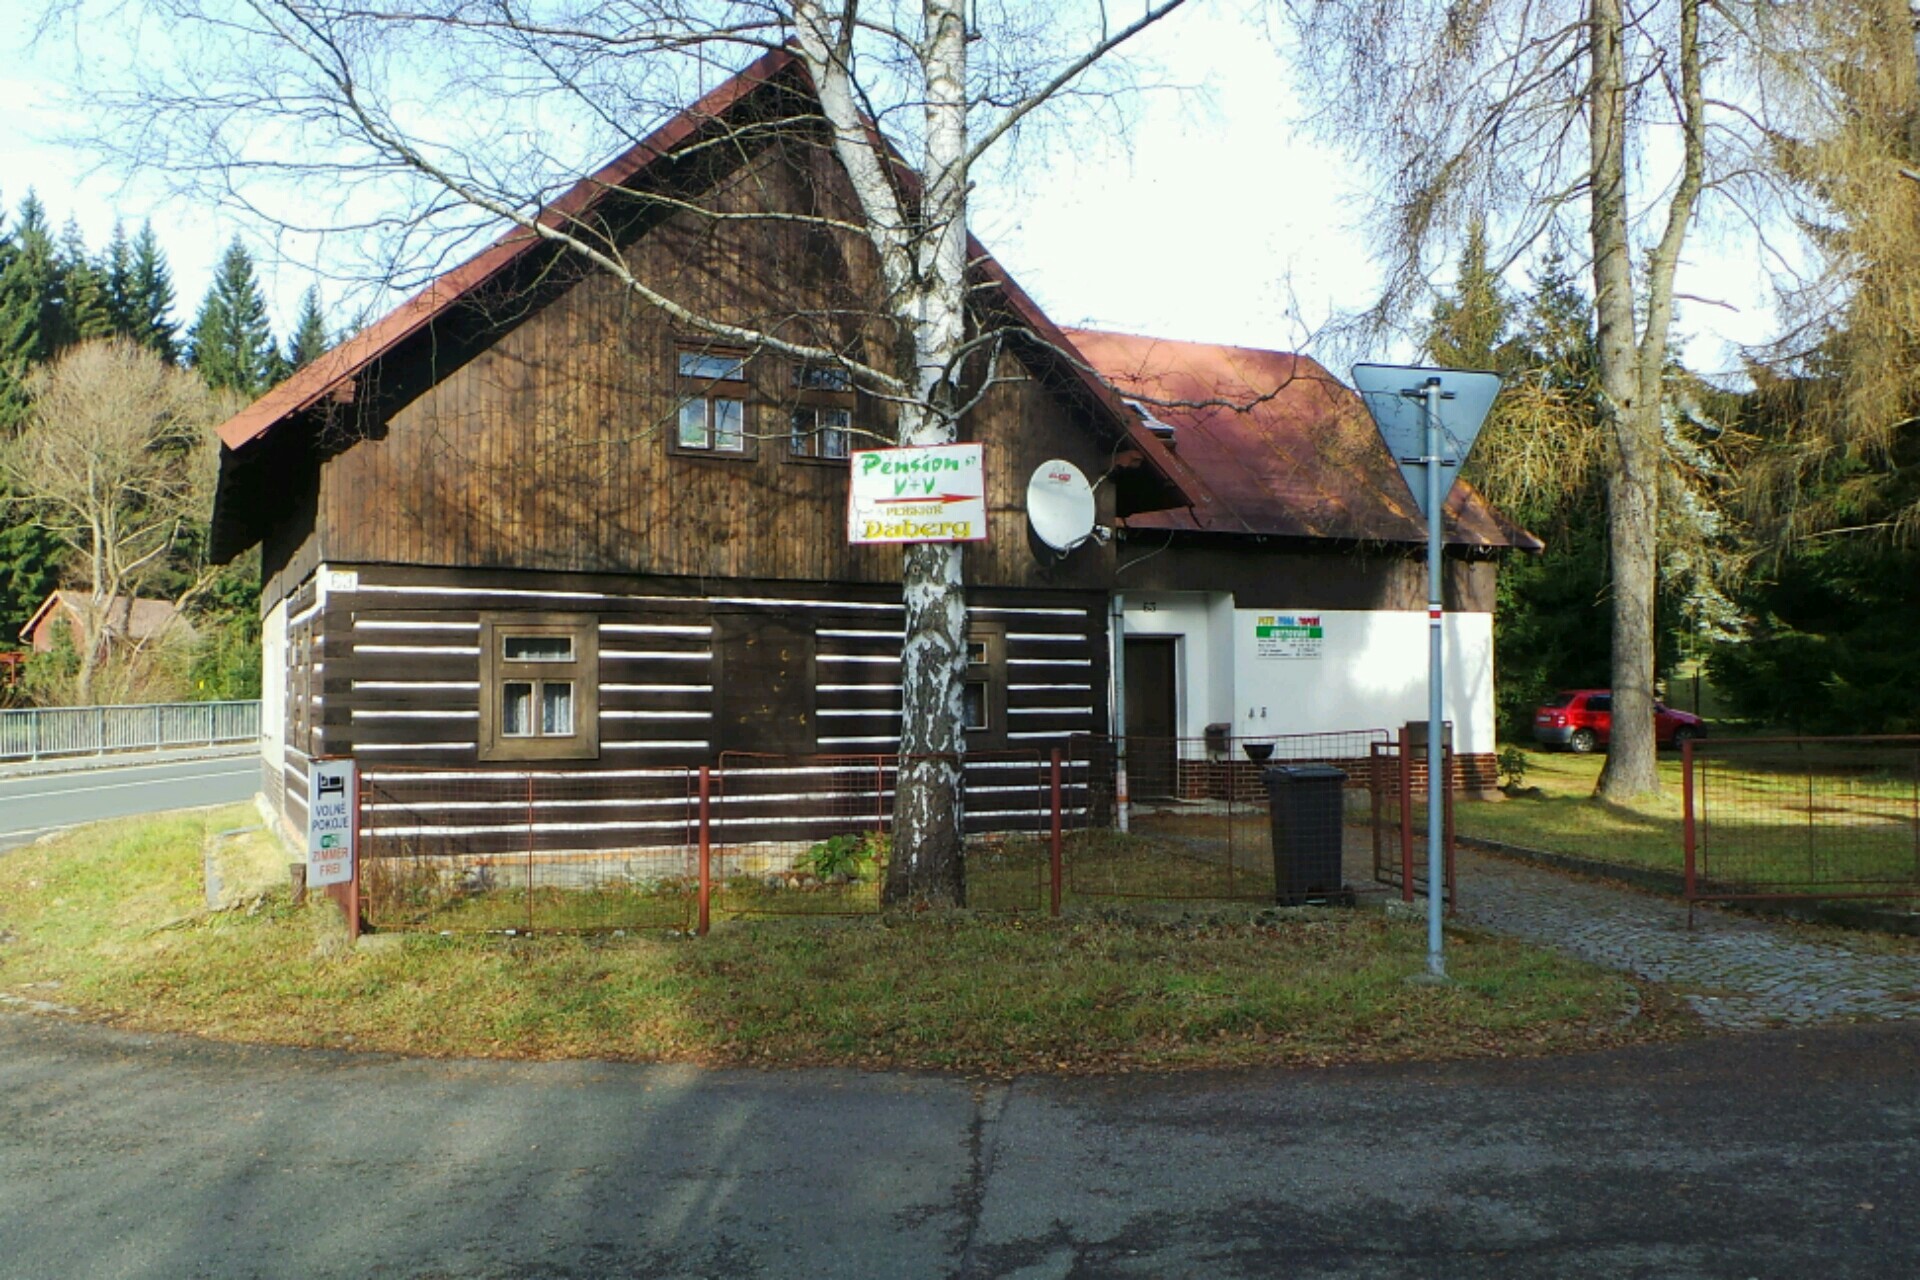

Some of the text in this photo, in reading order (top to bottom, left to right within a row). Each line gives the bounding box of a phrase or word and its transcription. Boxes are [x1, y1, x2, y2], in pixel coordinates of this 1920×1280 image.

[861, 453, 959, 476] Pension
[311, 816, 349, 832] POKOJE
[311, 847, 349, 864] ZIMMER
[319, 863, 340, 877] FREI
